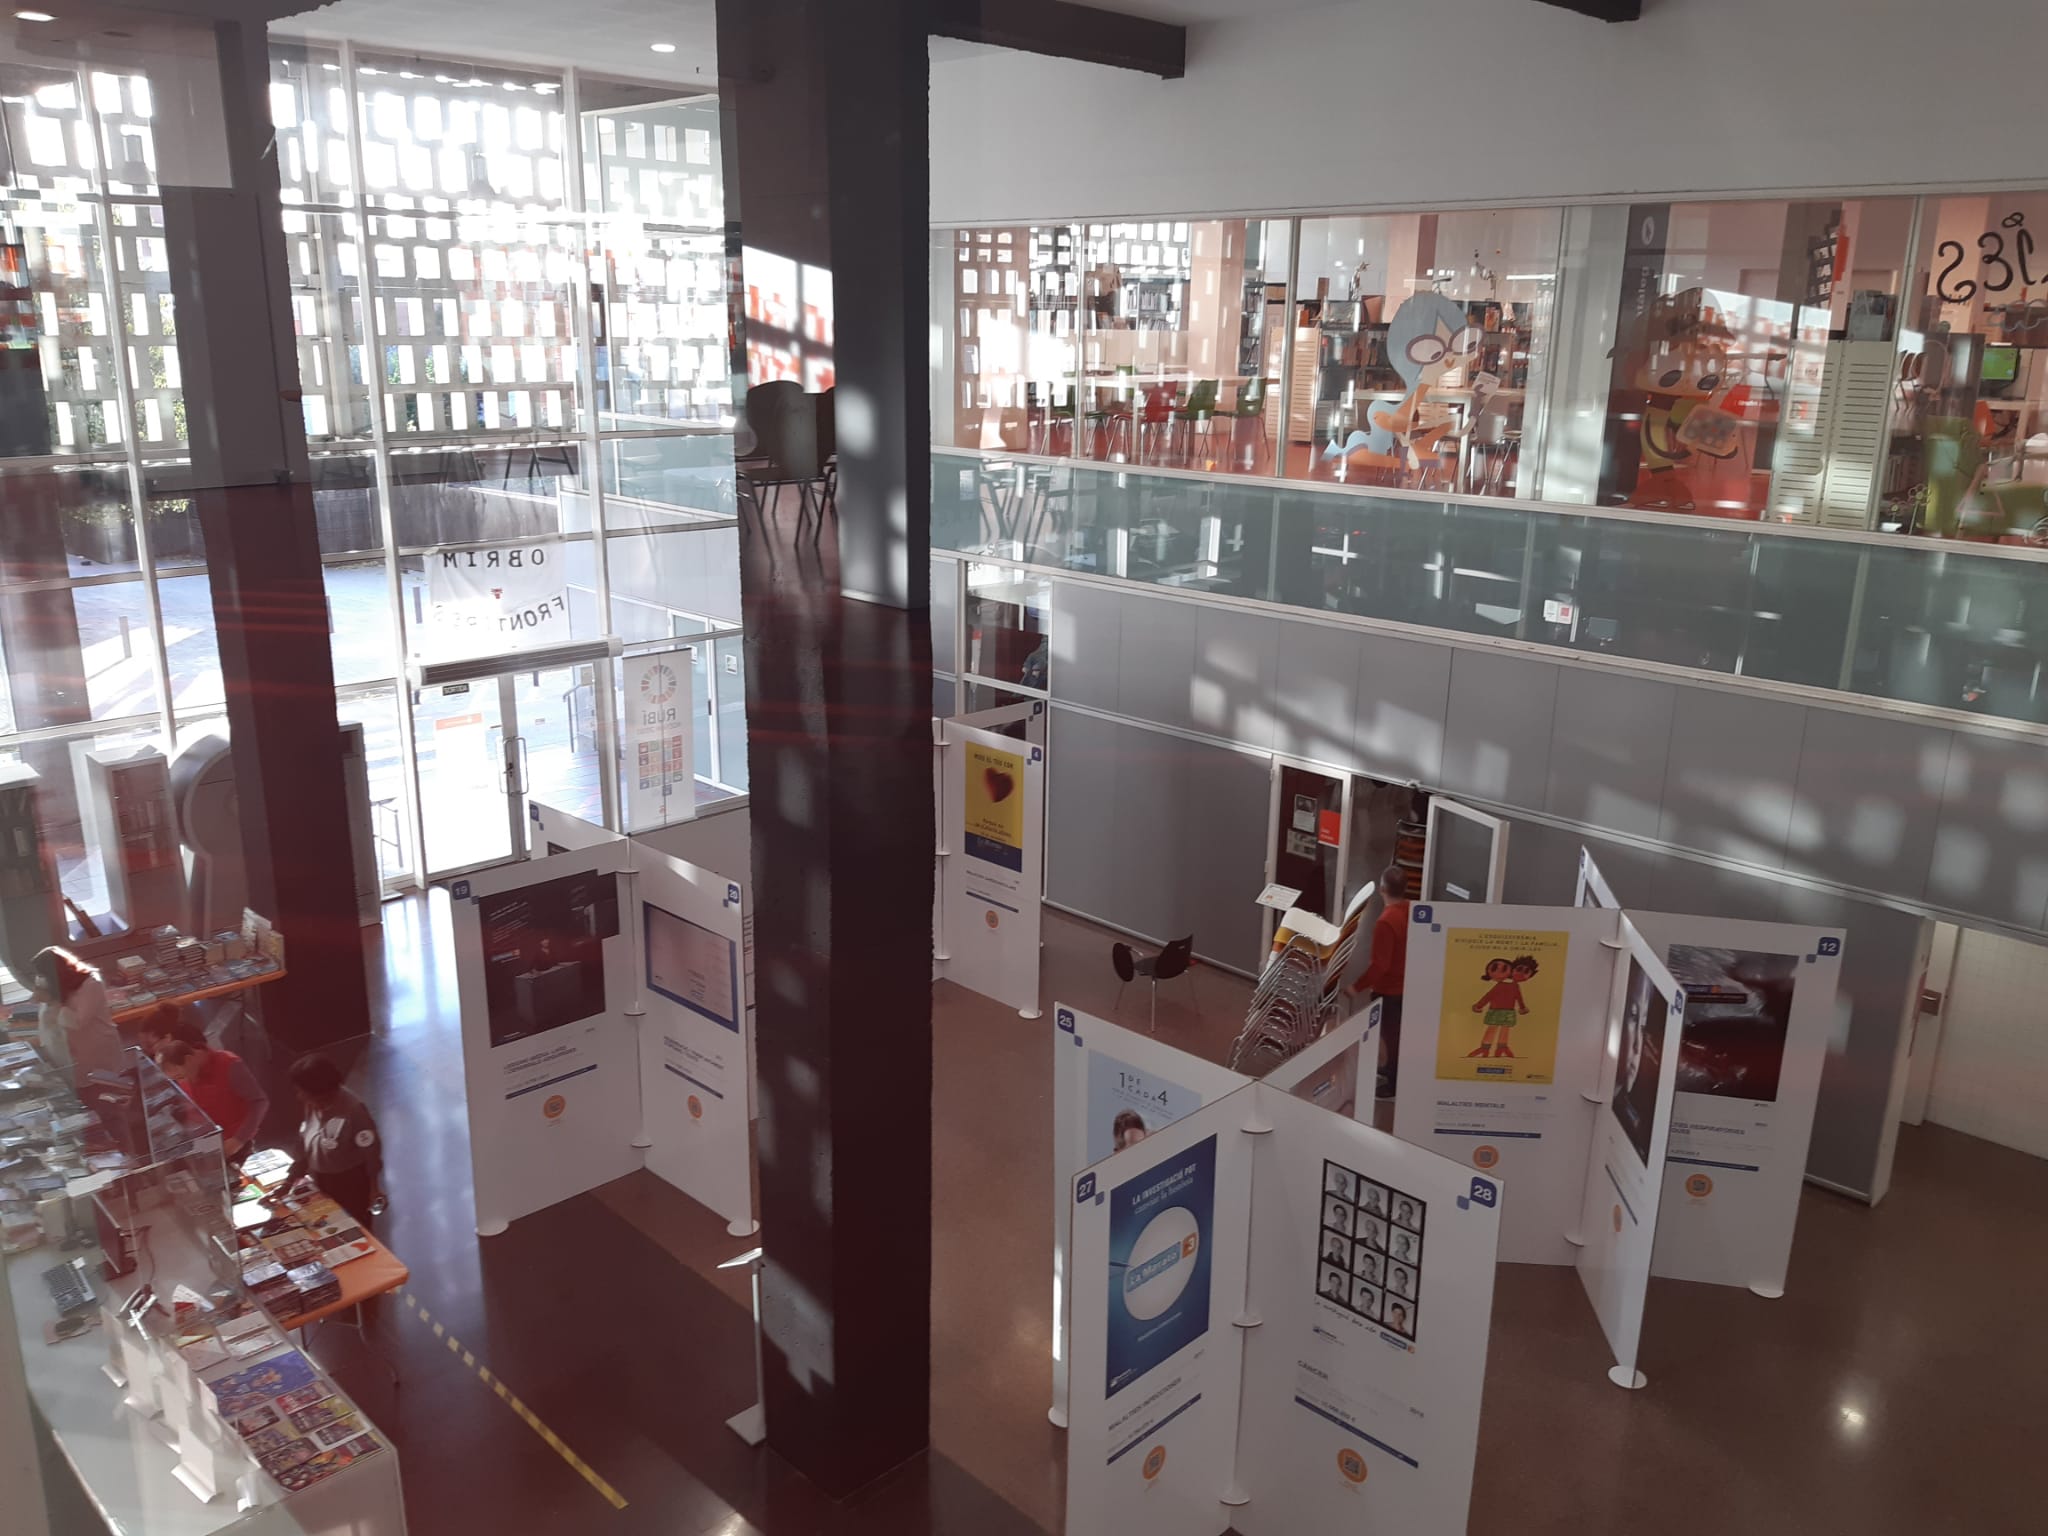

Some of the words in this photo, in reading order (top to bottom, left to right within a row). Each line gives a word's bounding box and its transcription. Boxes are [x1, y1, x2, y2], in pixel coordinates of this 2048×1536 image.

[455, 885, 468, 895] 19
[1418, 910, 1426, 919] 9
[1821, 942, 1836, 952] 12
[1059, 1014, 1073, 1028] 25
[1119, 1072, 1125, 1089] 1
[1157, 1090, 1168, 1106] 4
[1079, 1180, 1093, 1197] 27
[1473, 1184, 1492, 1201] 28
